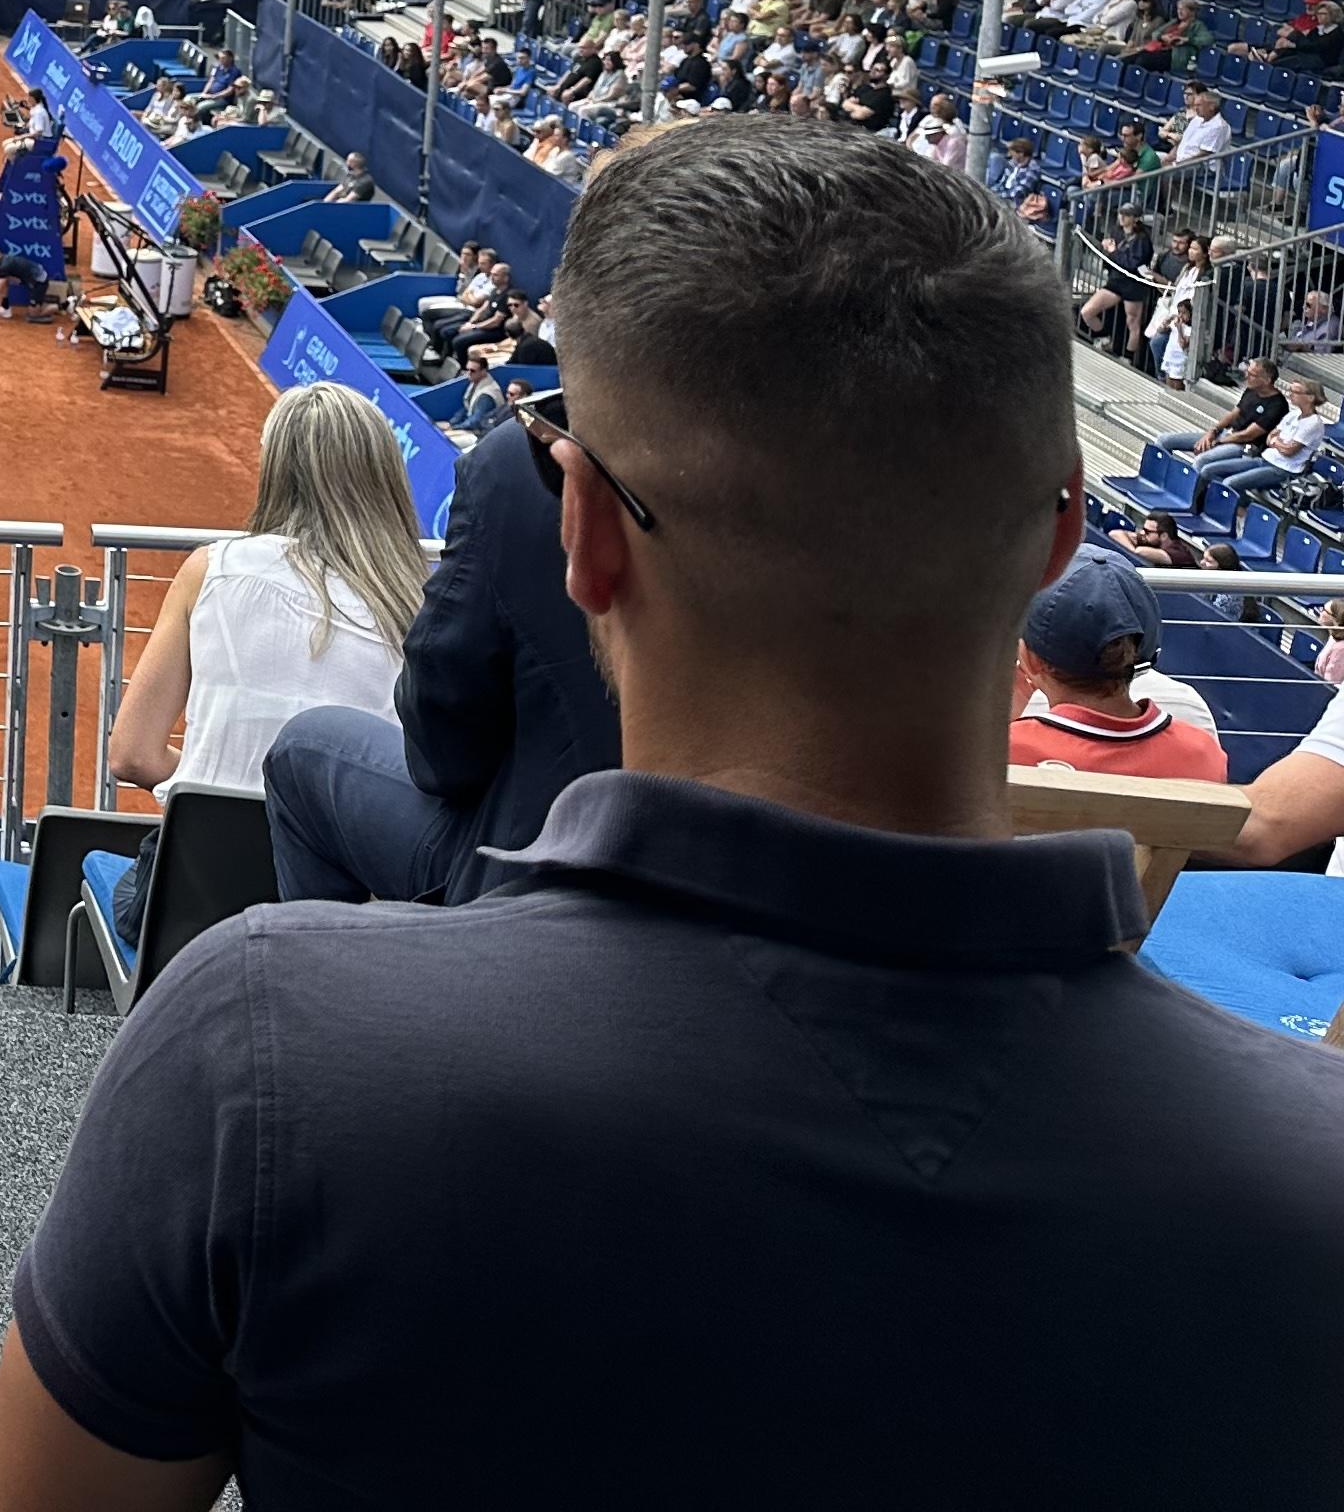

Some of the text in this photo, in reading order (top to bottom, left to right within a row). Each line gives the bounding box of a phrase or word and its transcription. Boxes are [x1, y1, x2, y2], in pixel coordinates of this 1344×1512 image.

[108, 120, 144, 169] RADO
[24, 191, 48, 205] vtx
[23, 216, 49, 231] vtx
[23, 242, 52, 258] vtx
[306, 335, 339, 376] GRAND
